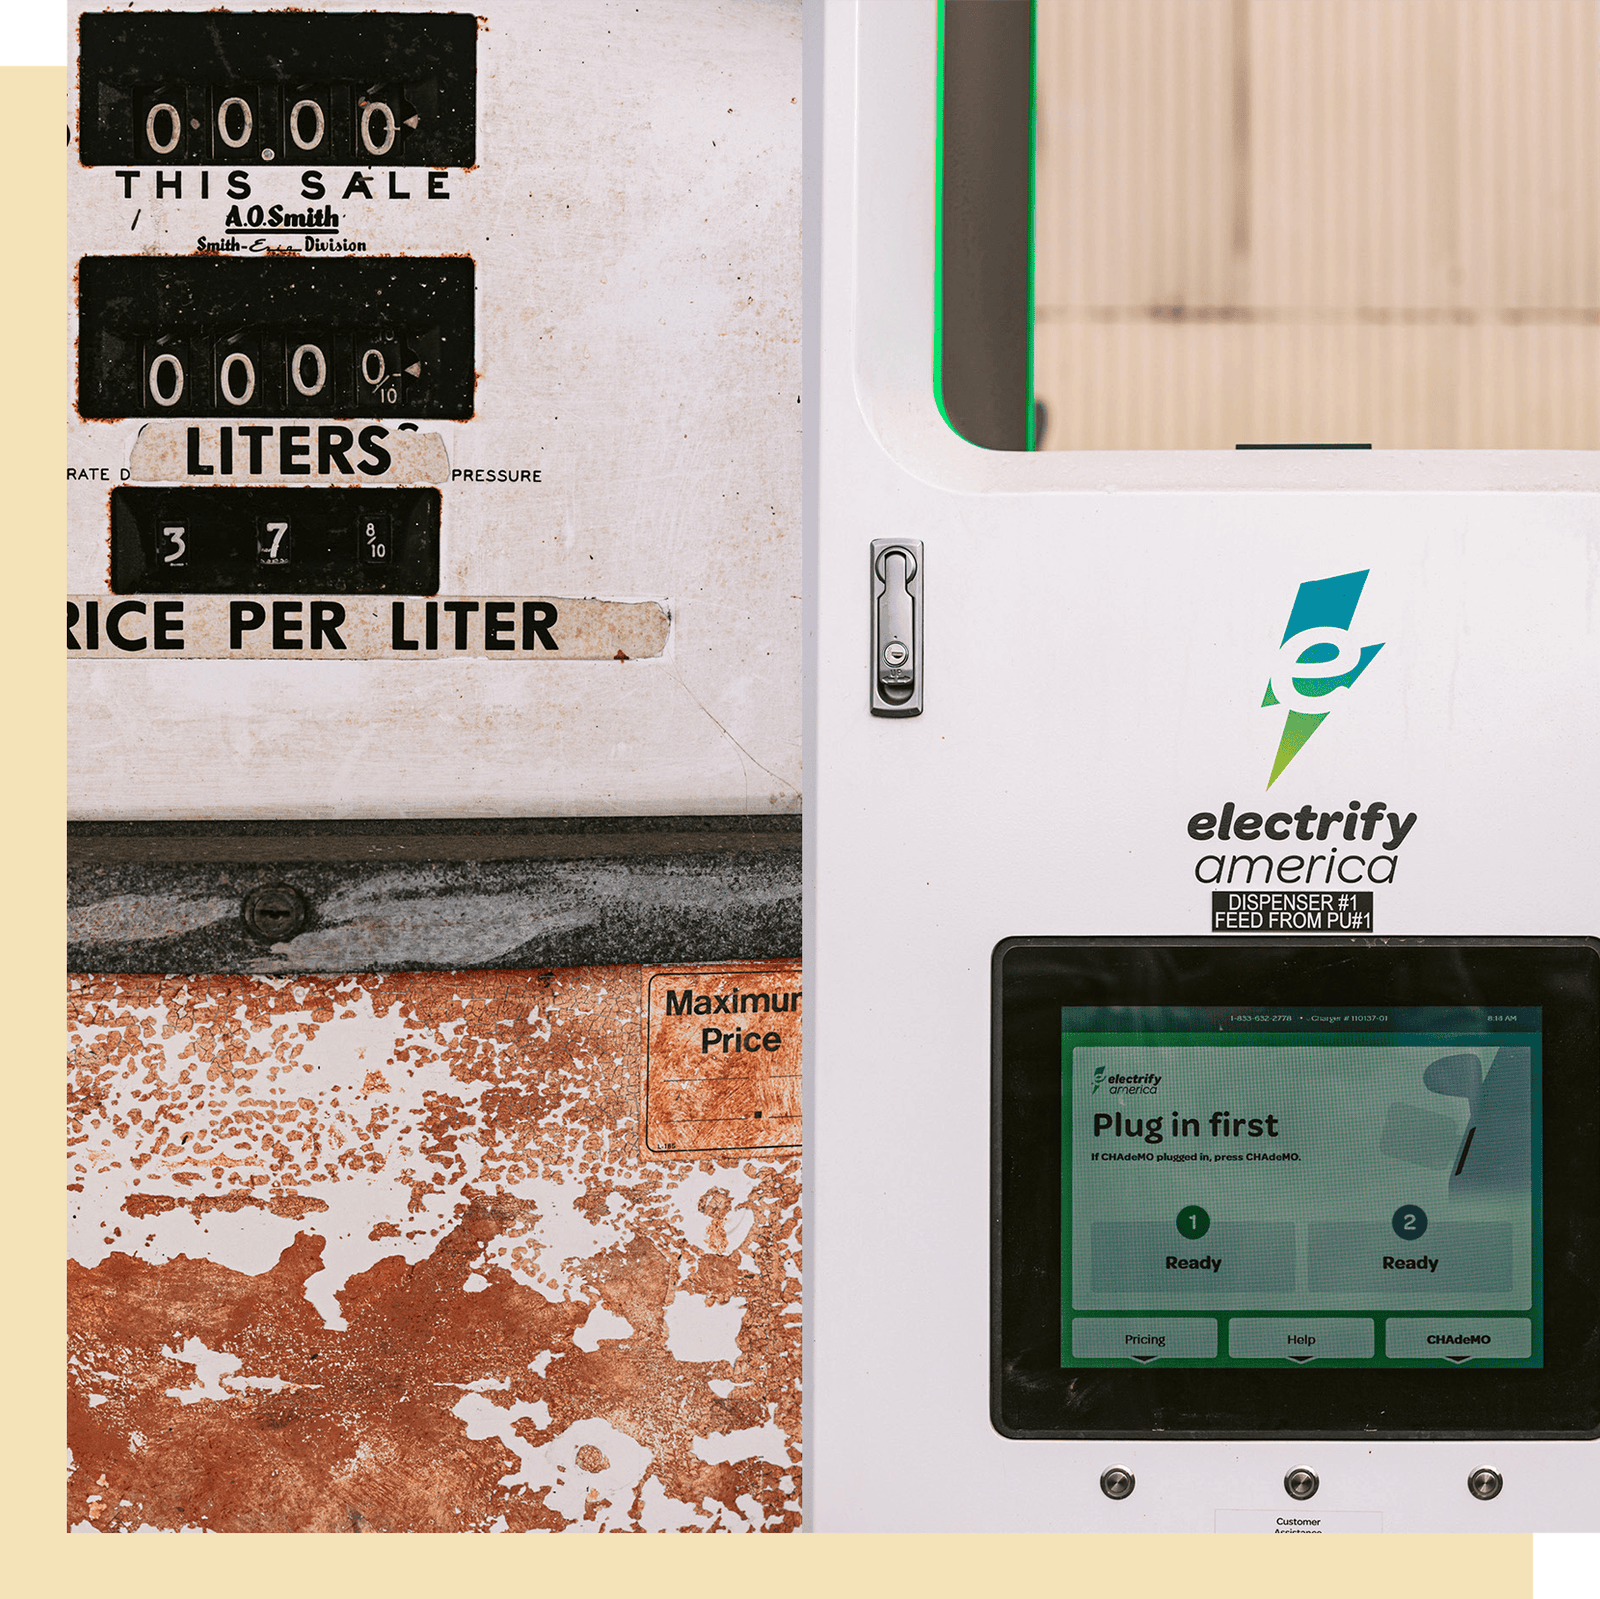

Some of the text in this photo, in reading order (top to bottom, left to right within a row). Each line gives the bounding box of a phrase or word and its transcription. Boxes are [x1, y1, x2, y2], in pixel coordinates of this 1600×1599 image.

[115, 170, 450, 200] THIS SALE
[304, 236, 367, 252] Division
[186, 425, 392, 476] LITERS
[452, 469, 542, 483] PRESSURE
[230, 601, 347, 650] PER
[391, 602, 560, 650] LITER
[1188, 801, 1418, 851] electrify
[1195, 847, 1399, 884] america
[1229, 894, 1357, 911] DISPENSER #1
[1215, 912, 1372, 929] FEED FROM PU#1
[702, 1027, 782, 1054] Price
[1108, 1073, 1162, 1086] electrify
[1109, 1085, 1158, 1095] america
[1094, 1111, 1279, 1144] Plug in first
[1091, 1153, 1302, 1163] If CHAdeMO plugged in, press CHAdeMO.
[1403, 1214, 1417, 1231] 2
[1165, 1255, 1222, 1272] Ready
[1382, 1255, 1439, 1272] Ready
[1125, 1333, 1166, 1346] Pricing
[1287, 1333, 1316, 1347] Help
[1427, 1334, 1491, 1345] CHAdeMO
[1276, 1517, 1321, 1526] Customer
